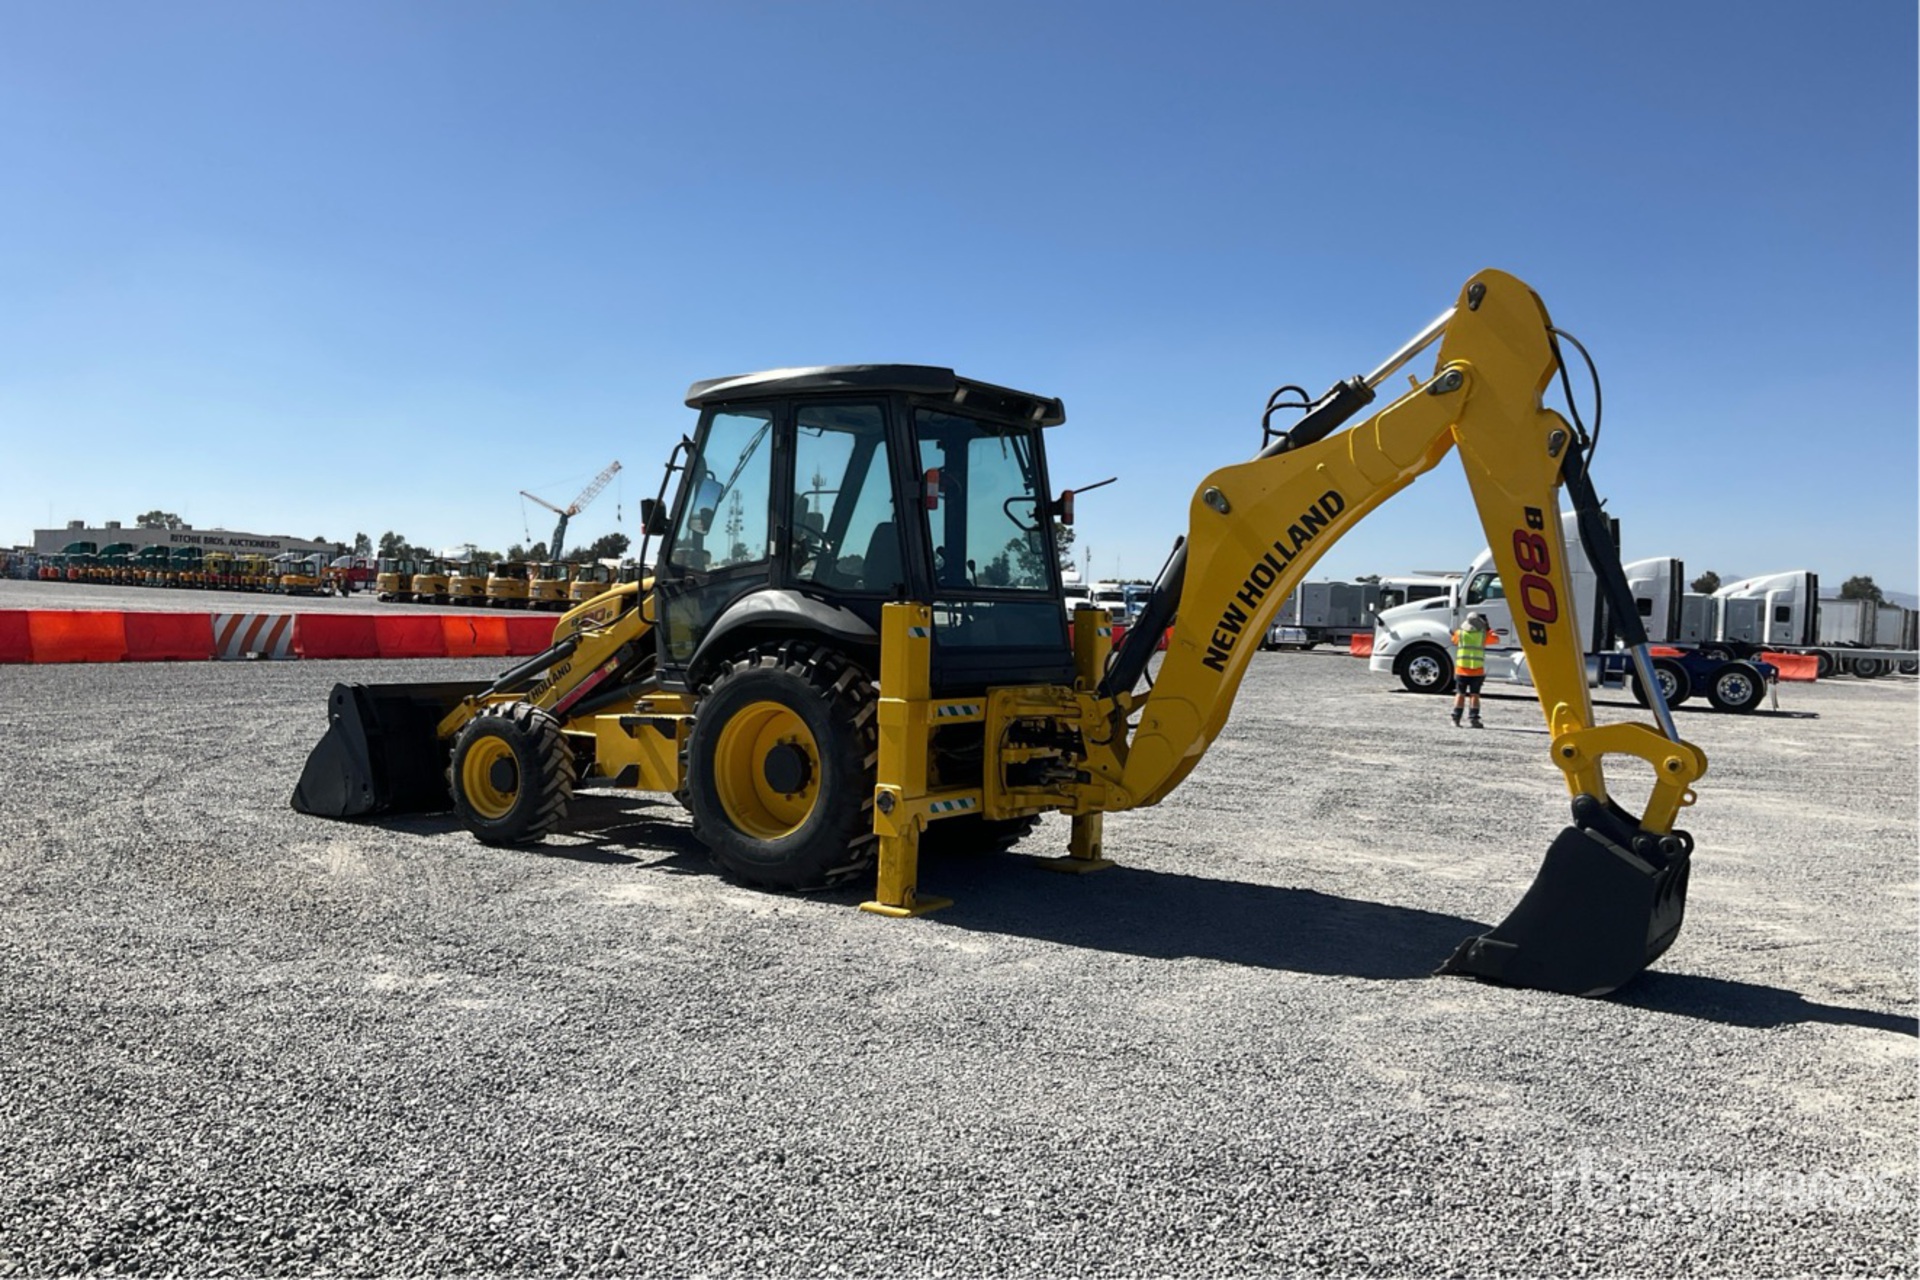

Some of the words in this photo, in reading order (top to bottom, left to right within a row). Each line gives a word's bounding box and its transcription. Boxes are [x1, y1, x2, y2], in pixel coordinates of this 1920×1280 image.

[170, 534, 200, 544] RITCHIE
[228, 538, 280, 549] AUCTIONEERS
[1202, 602, 1248, 672] NEW
[1236, 490, 1345, 610] HOLLAND
[531, 662, 572, 699] HOLLAND
